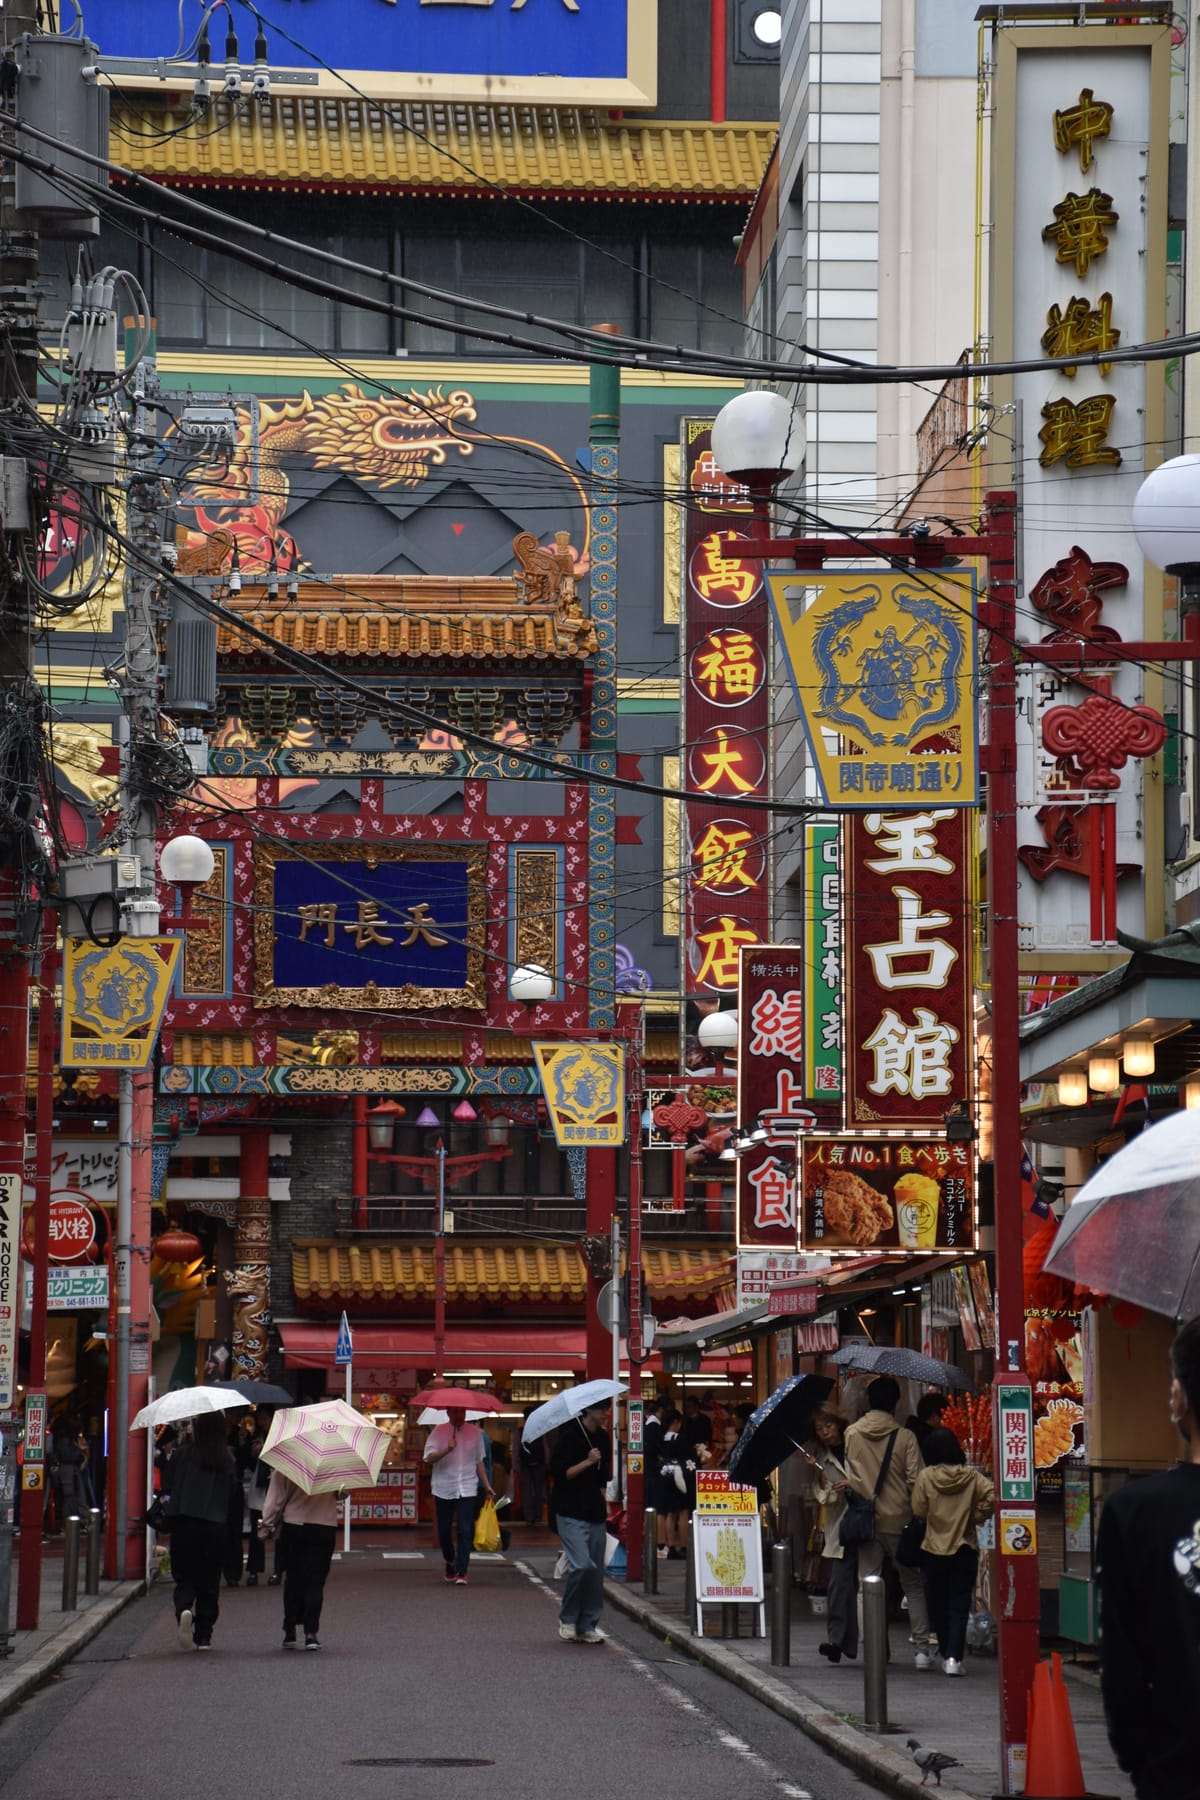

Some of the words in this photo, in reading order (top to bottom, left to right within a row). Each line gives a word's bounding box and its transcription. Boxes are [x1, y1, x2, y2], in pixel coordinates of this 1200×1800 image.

[1038, 87, 1120, 469] 中華料理
[694, 531, 757, 987] 萬福大飯店
[839, 760, 962, 793] 関帝廟通り
[72, 1042, 142, 1061] 関帝廟通り
[563, 1126, 618, 1141] 関帝廟通り
[28, 1409, 42, 1448] 関帝廟
[1005, 1411, 1028, 1479] 関帝廟
